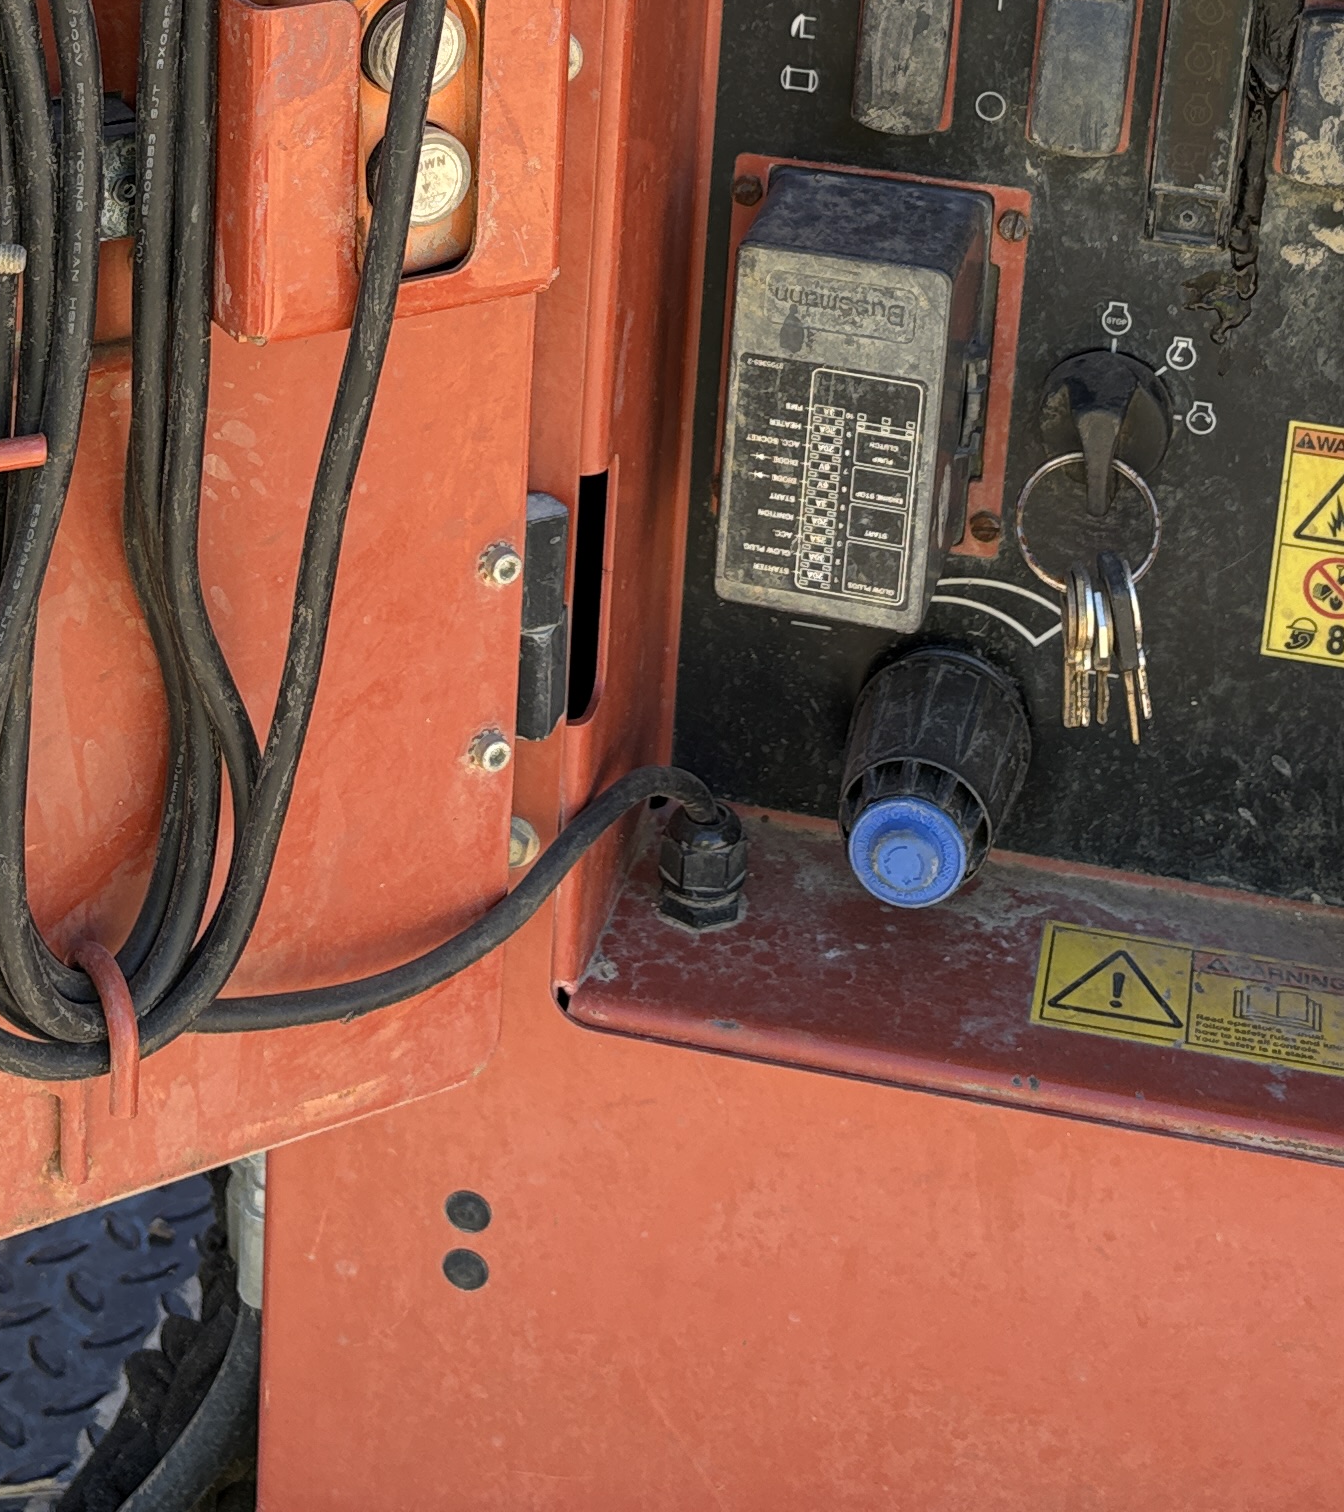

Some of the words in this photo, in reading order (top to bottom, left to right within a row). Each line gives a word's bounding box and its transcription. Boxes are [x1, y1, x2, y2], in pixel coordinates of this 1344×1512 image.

[775, 286, 905, 328] Bussmann
[1106, 316, 1128, 326] STOP
[753, 562, 789, 574] STARTER
